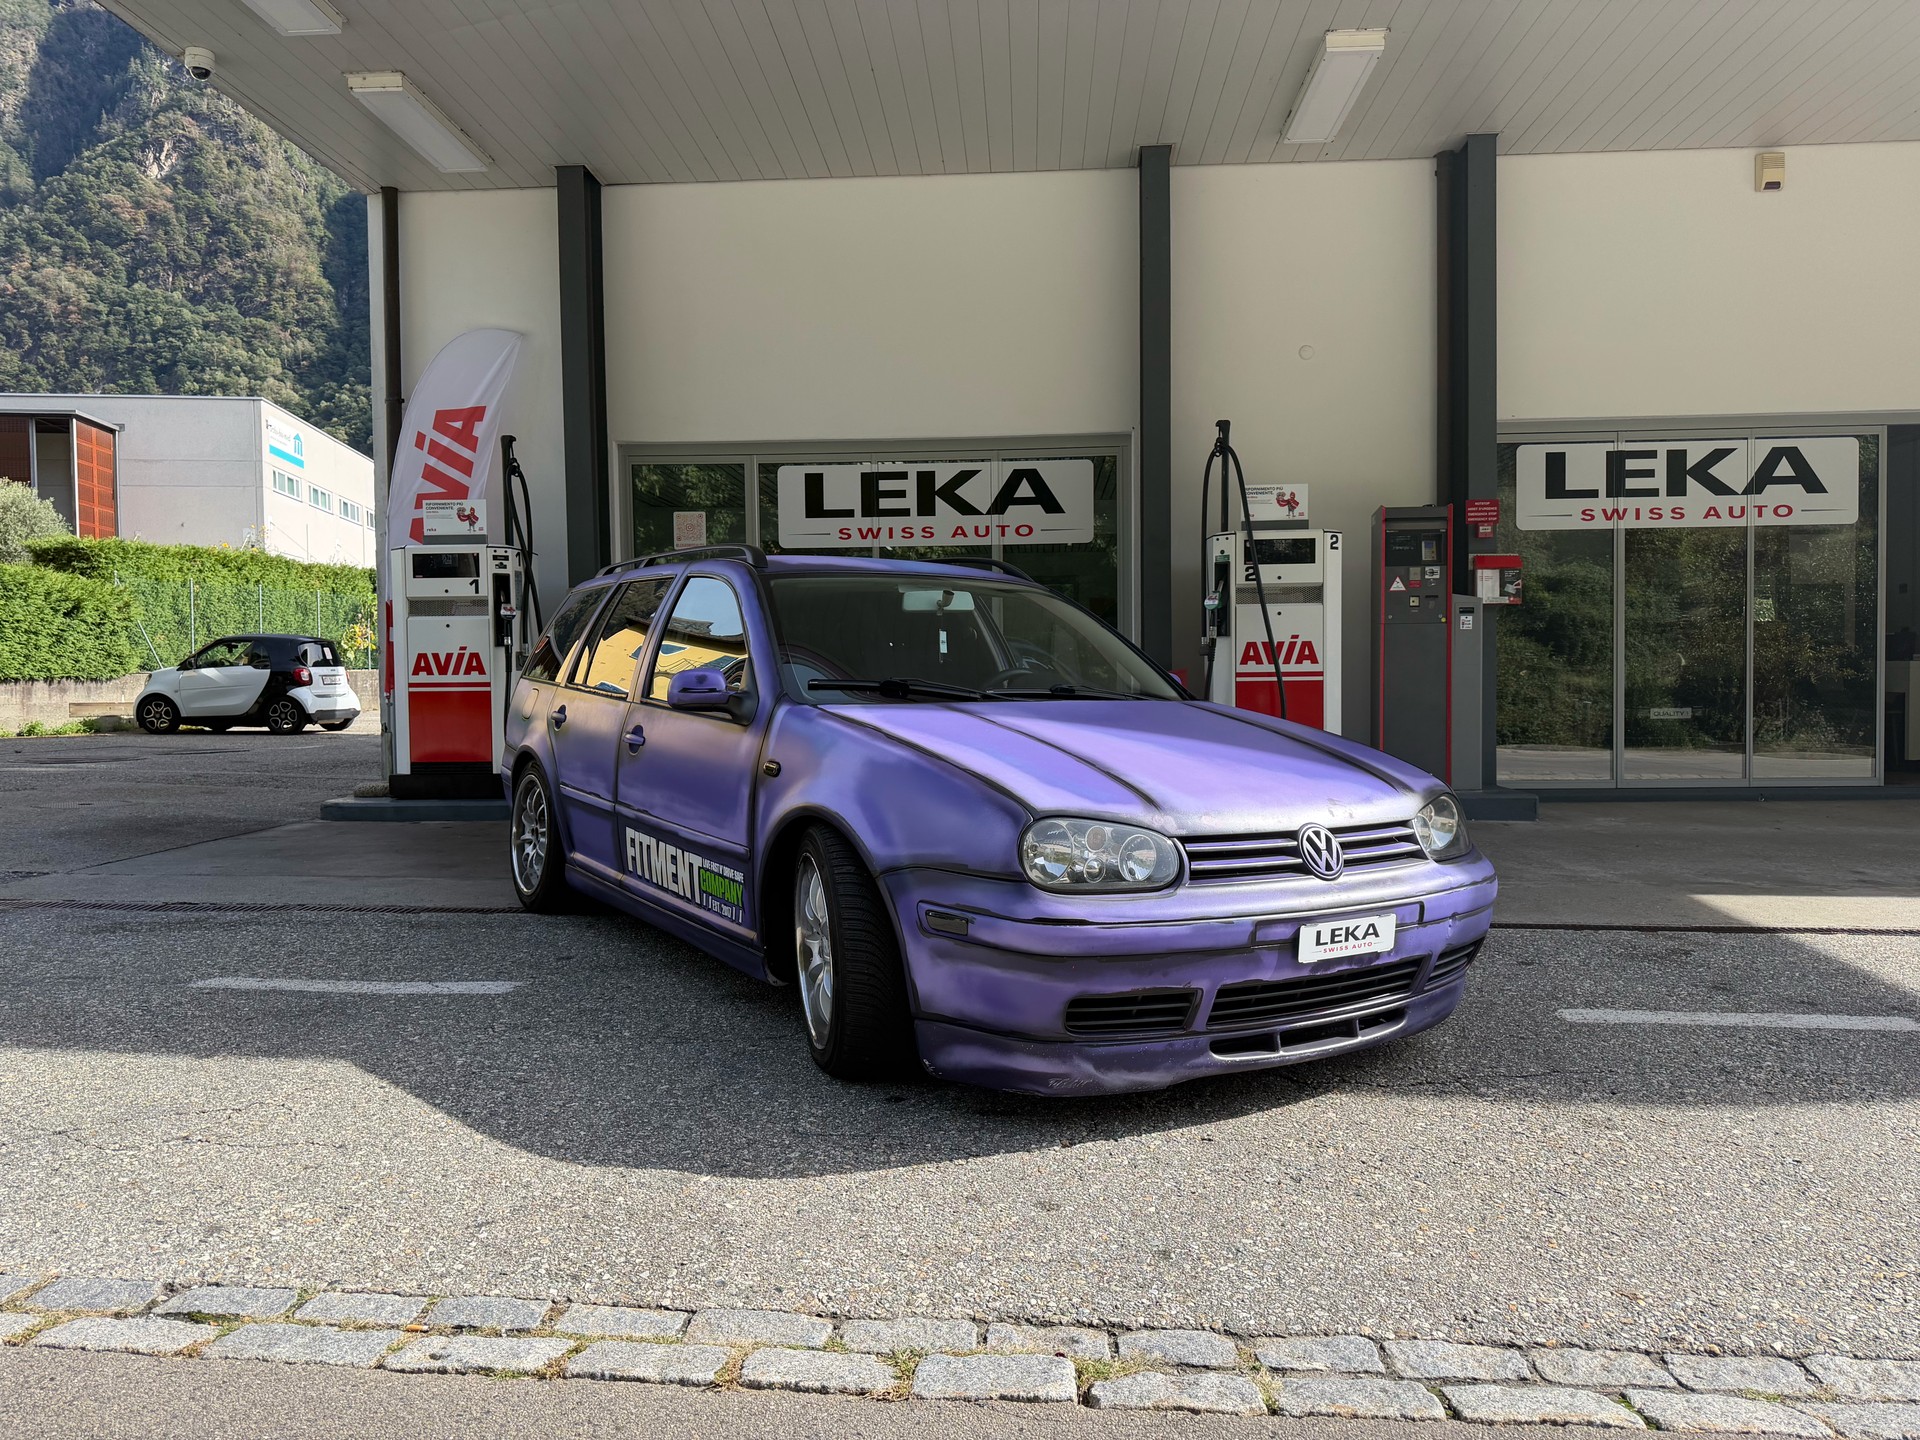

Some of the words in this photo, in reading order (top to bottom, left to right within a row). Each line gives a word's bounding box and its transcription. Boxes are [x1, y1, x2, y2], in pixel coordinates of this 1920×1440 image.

[1545, 446, 1829, 500] LEKA
[804, 468, 1066, 518] LEKA
[1580, 506, 1686, 522] SWISS
[1702, 504, 1794, 520] AUTO
[838, 526, 935, 540] SWISS
[950, 524, 1034, 539] AUTO
[1330, 534, 1339, 550] 2
[515, 551, 521, 567] 1
[1245, 566, 1258, 582] 2
[468, 578, 480, 595] 1
[625, 826, 703, 904] FITMENT
[700, 868, 743, 907] COMPANY
[1315, 923, 1380, 947] LEKA
[1323, 945, 1349, 954] SWISS
[1352, 941, 1373, 950] AUTO
